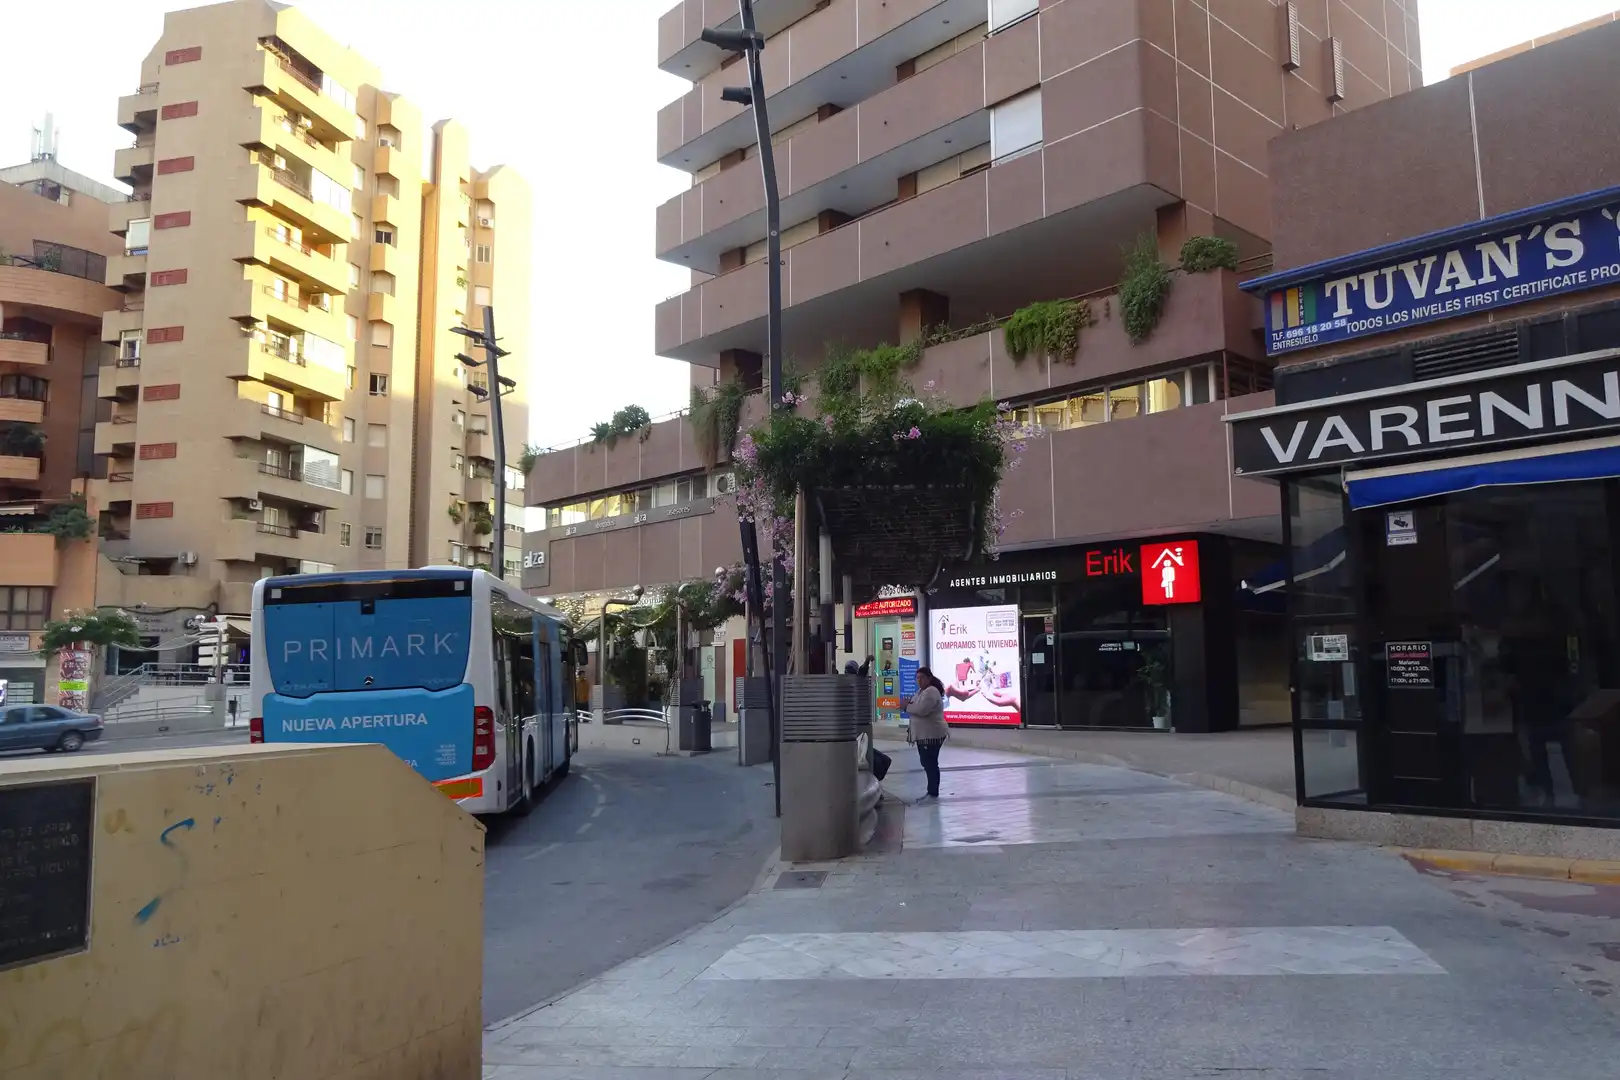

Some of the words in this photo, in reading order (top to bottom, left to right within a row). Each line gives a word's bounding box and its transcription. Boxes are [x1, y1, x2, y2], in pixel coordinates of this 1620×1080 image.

[1346, 314, 1383, 334] TODOS
[1385, 310, 1409, 327] LOS
[1411, 299, 1461, 319] NIVELES
[1464, 289, 1499, 308] FIRST
[1502, 267, 1587, 300] CERTIFICATE
[1272, 332, 1285, 342] TLF.
[1286, 328, 1304, 338] 696
[1306, 324, 1318, 334] 18
[1320, 322, 1331, 331] 20
[1272, 334, 1318, 350] ENTRESUELO
[1260, 370, 1620, 464] VARENN
[524, 551, 544, 568] alza
[1086, 548, 1134, 576] Erik
[950, 576, 986, 588] AGENTES
[990, 570, 1057, 584] INMOBILIARIOS
[880, 600, 912, 609] AUTORIZADO
[950, 624, 968, 635] Erik
[284, 632, 454, 663] PRIMARK
[936, 641, 976, 650] COMPRAMOS
[978, 640, 986, 648] TU
[988, 639, 1018, 648] VIVIENDA
[282, 718, 336, 733] NUEVA
[341, 712, 428, 730] APERTURA
